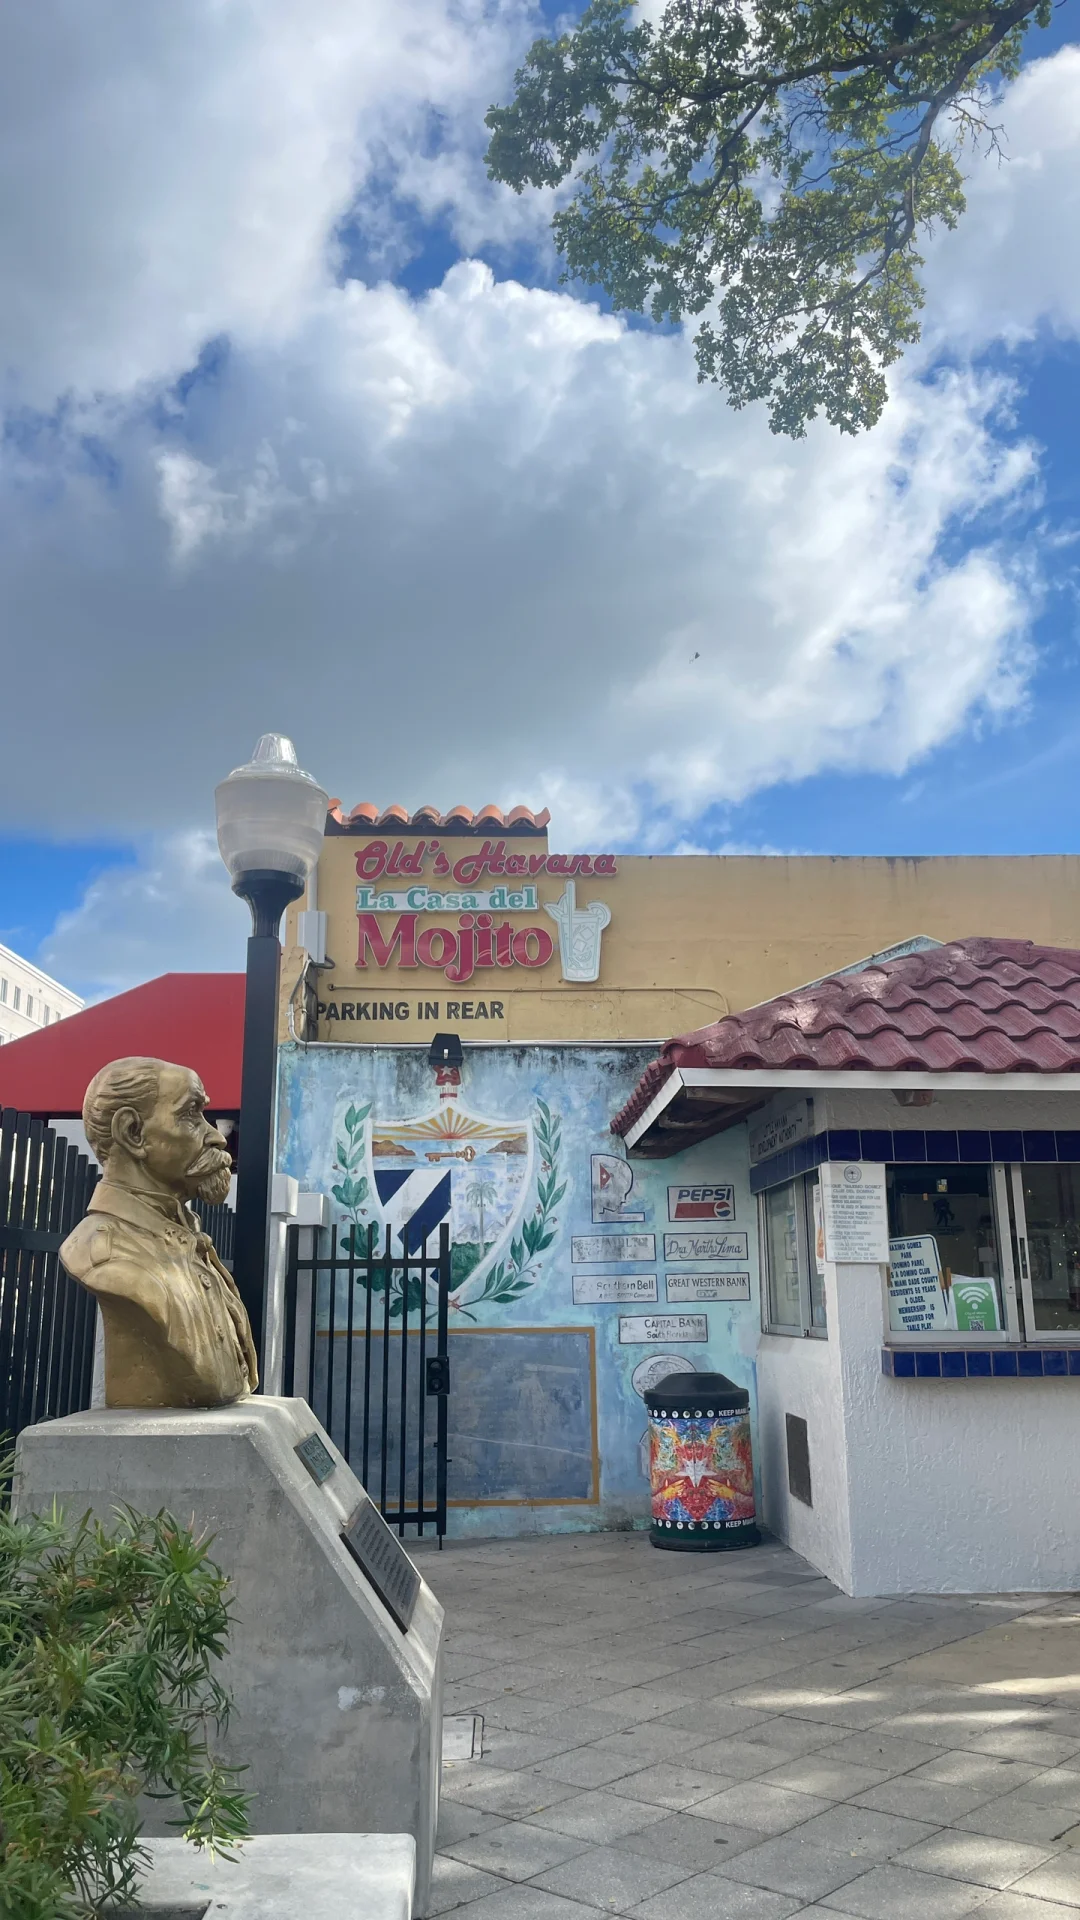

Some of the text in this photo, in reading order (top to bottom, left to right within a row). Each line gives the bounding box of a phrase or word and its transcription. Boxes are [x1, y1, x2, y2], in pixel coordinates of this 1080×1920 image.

[355, 840, 617, 885] Old's Havana
[357, 886, 537, 909] La Casa del
[356, 913, 554, 982] Mojito
[316, 1001, 504, 1020] PARKING IN REAR
[678, 1188, 731, 1201] PEPSI
[708, 1236, 743, 1258] Lima
[900, 1251, 912, 1259] PARK
[900, 1269, 918, 1277] DOMINO
[636, 1280, 654, 1290] Bell
[668, 1278, 747, 1287] GREAT WESTERN BANK
[908, 1277, 920, 1285] DADE
[921, 1275, 938, 1284] COUNTY
[914, 1286, 921, 1294] 55
[922, 1285, 937, 1293] YEARS
[898, 1304, 926, 1314] MEMBERSHIP
[902, 1314, 924, 1323] REQUIRED
[907, 1323, 920, 1331] TABLE
[718, 1409, 734, 1417] KEEP
[725, 1520, 741, 1528] KEEP
